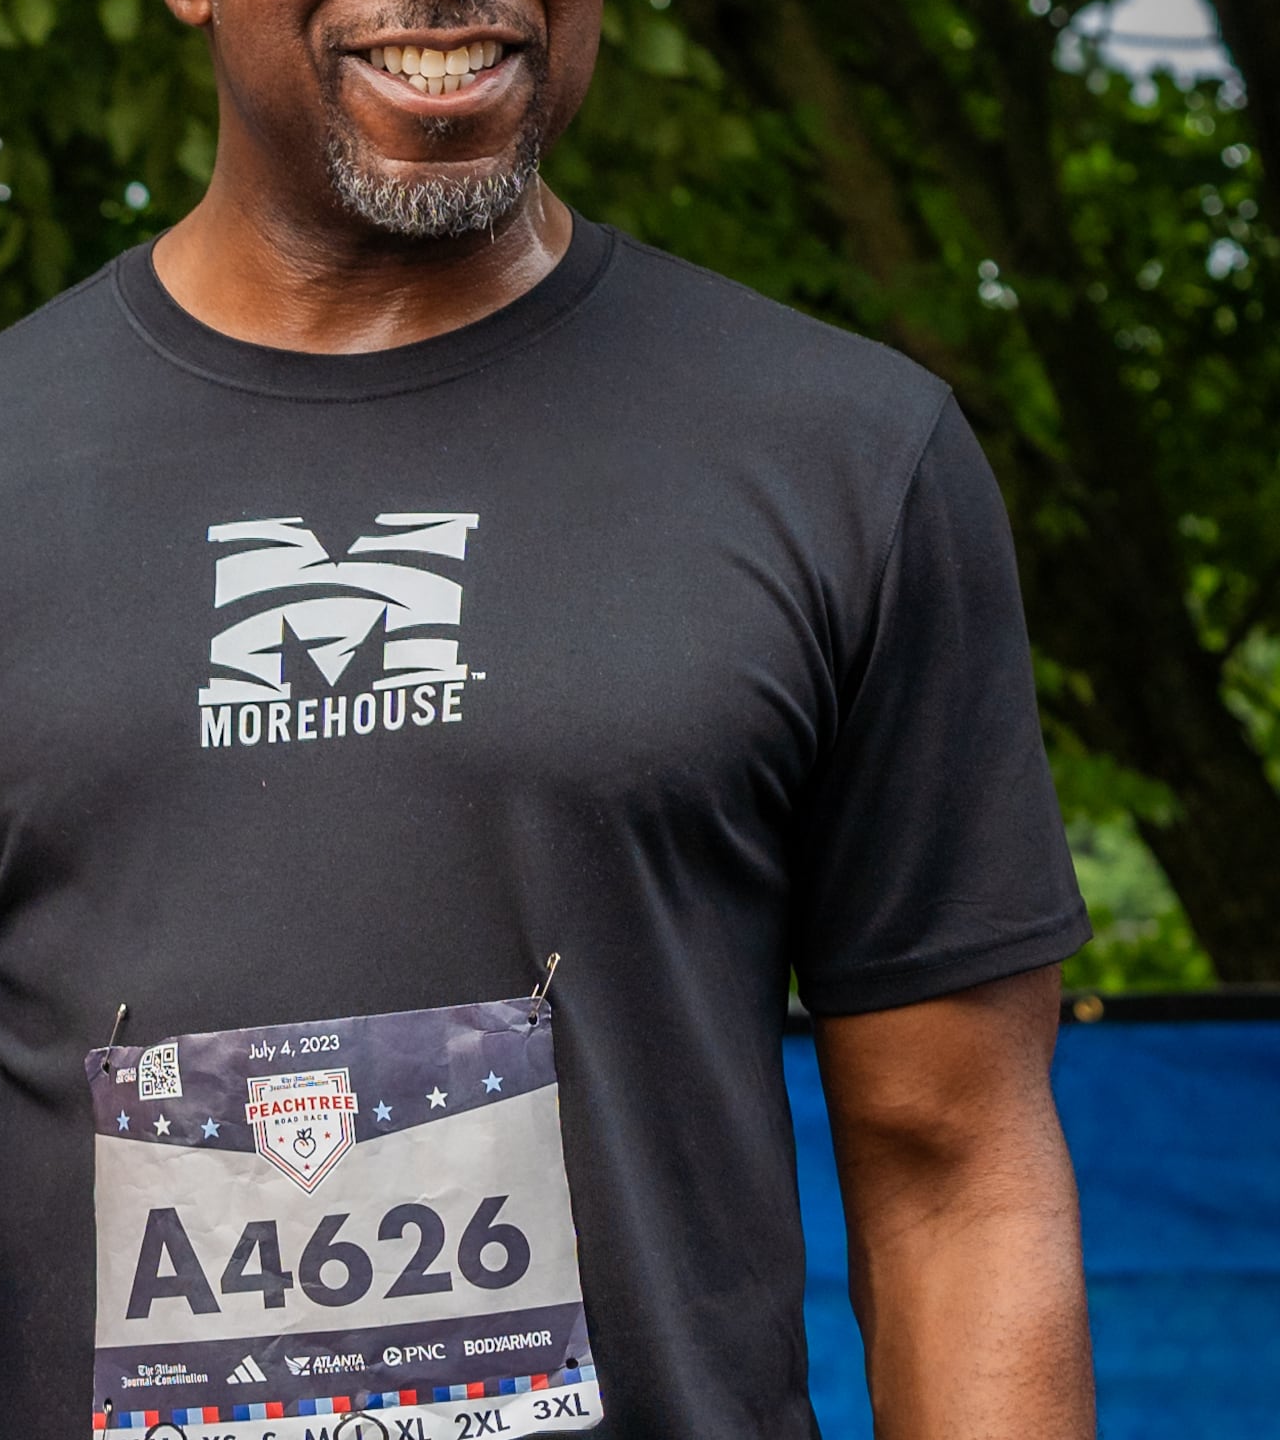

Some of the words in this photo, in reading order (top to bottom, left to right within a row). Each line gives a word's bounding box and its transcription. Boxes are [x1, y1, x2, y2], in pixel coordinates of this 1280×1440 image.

[200, 682, 465, 748] MOREHOUSE
[249, 1040, 276, 1062] July
[280, 1040, 296, 1057] 4,
[300, 1034, 340, 1053] 2023
[249, 1095, 355, 1120] PEACHTREE
[275, 1116, 298, 1125] ROAD
[125, 1195, 531, 1320] A4626
[404, 1343, 446, 1363] PNC
[464, 1330, 552, 1356] BODYARMOR
[138, 1364, 154, 1376] The
[155, 1363, 187, 1375] Atlanta
[312, 1353, 364, 1368] ATLANTA
[121, 1374, 208, 1389] Journal-Constitution
[454, 1409, 511, 1440] 2XL
[533, 1392, 590, 1420] 3XL
